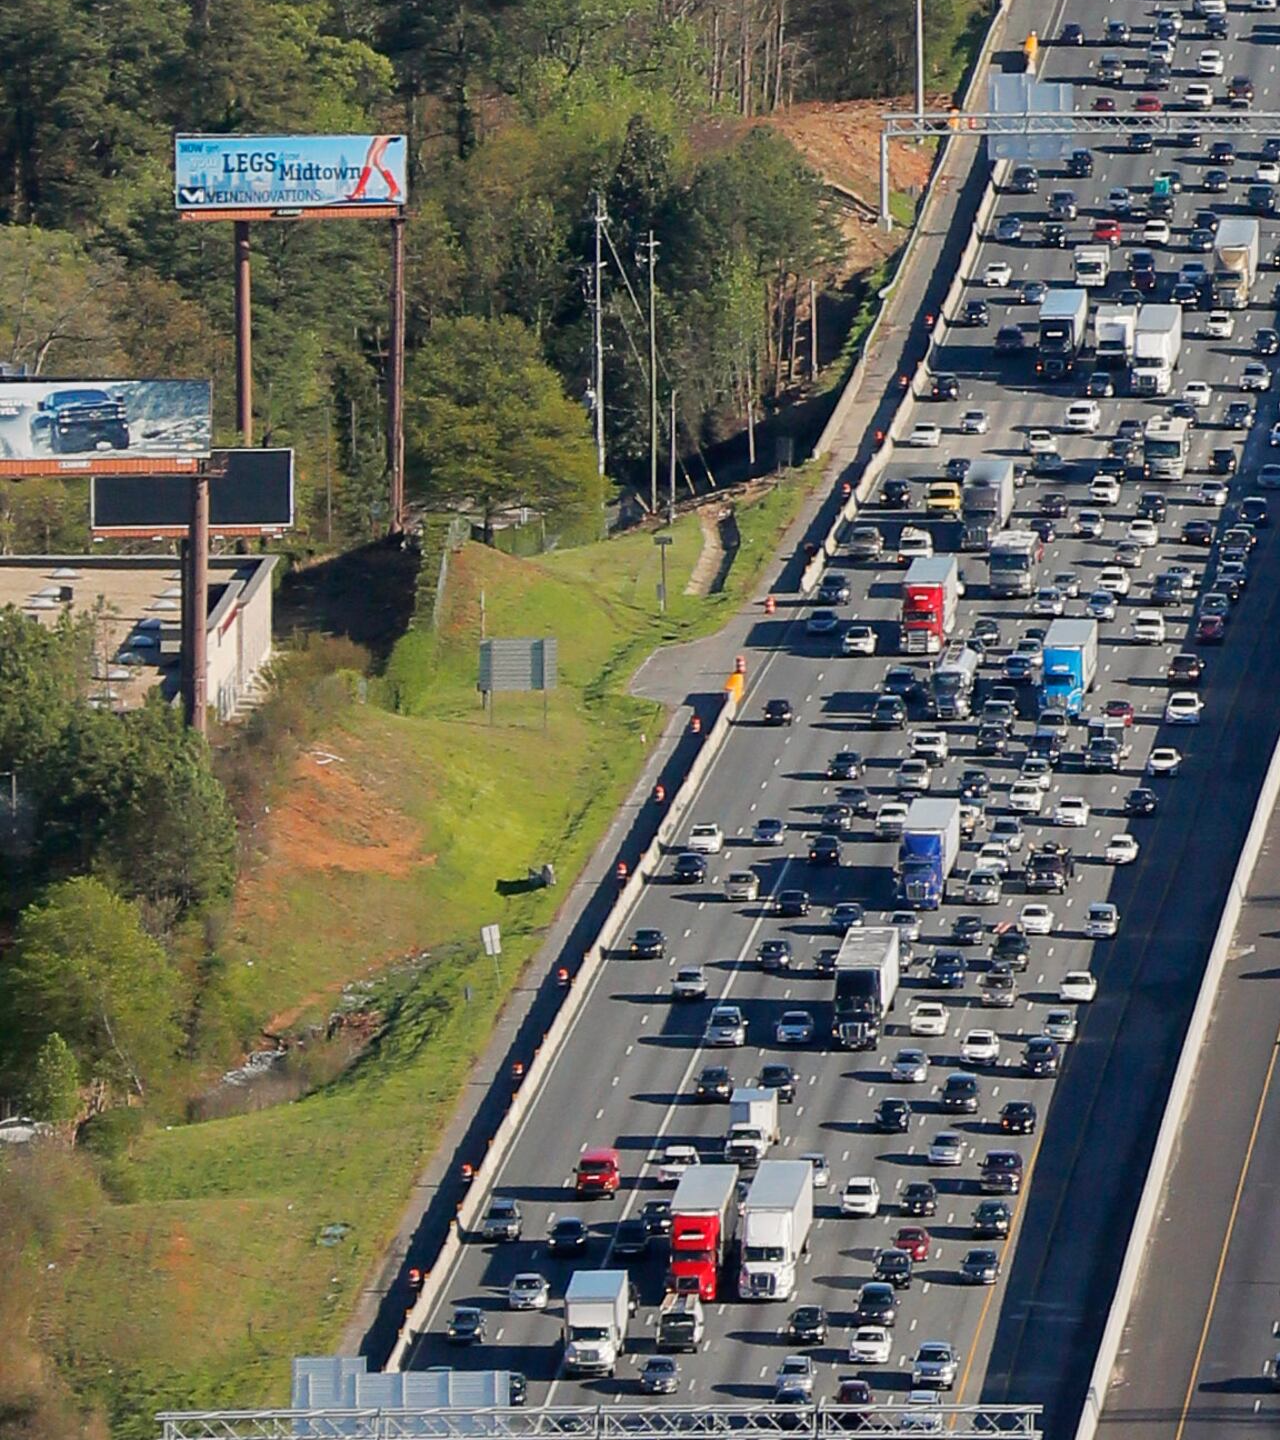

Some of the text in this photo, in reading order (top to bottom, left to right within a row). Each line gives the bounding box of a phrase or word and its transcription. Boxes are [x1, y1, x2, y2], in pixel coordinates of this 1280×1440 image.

[180, 143, 203, 153] NOW
[222, 152, 277, 173] LEGS
[279, 163, 361, 181] Midtown
